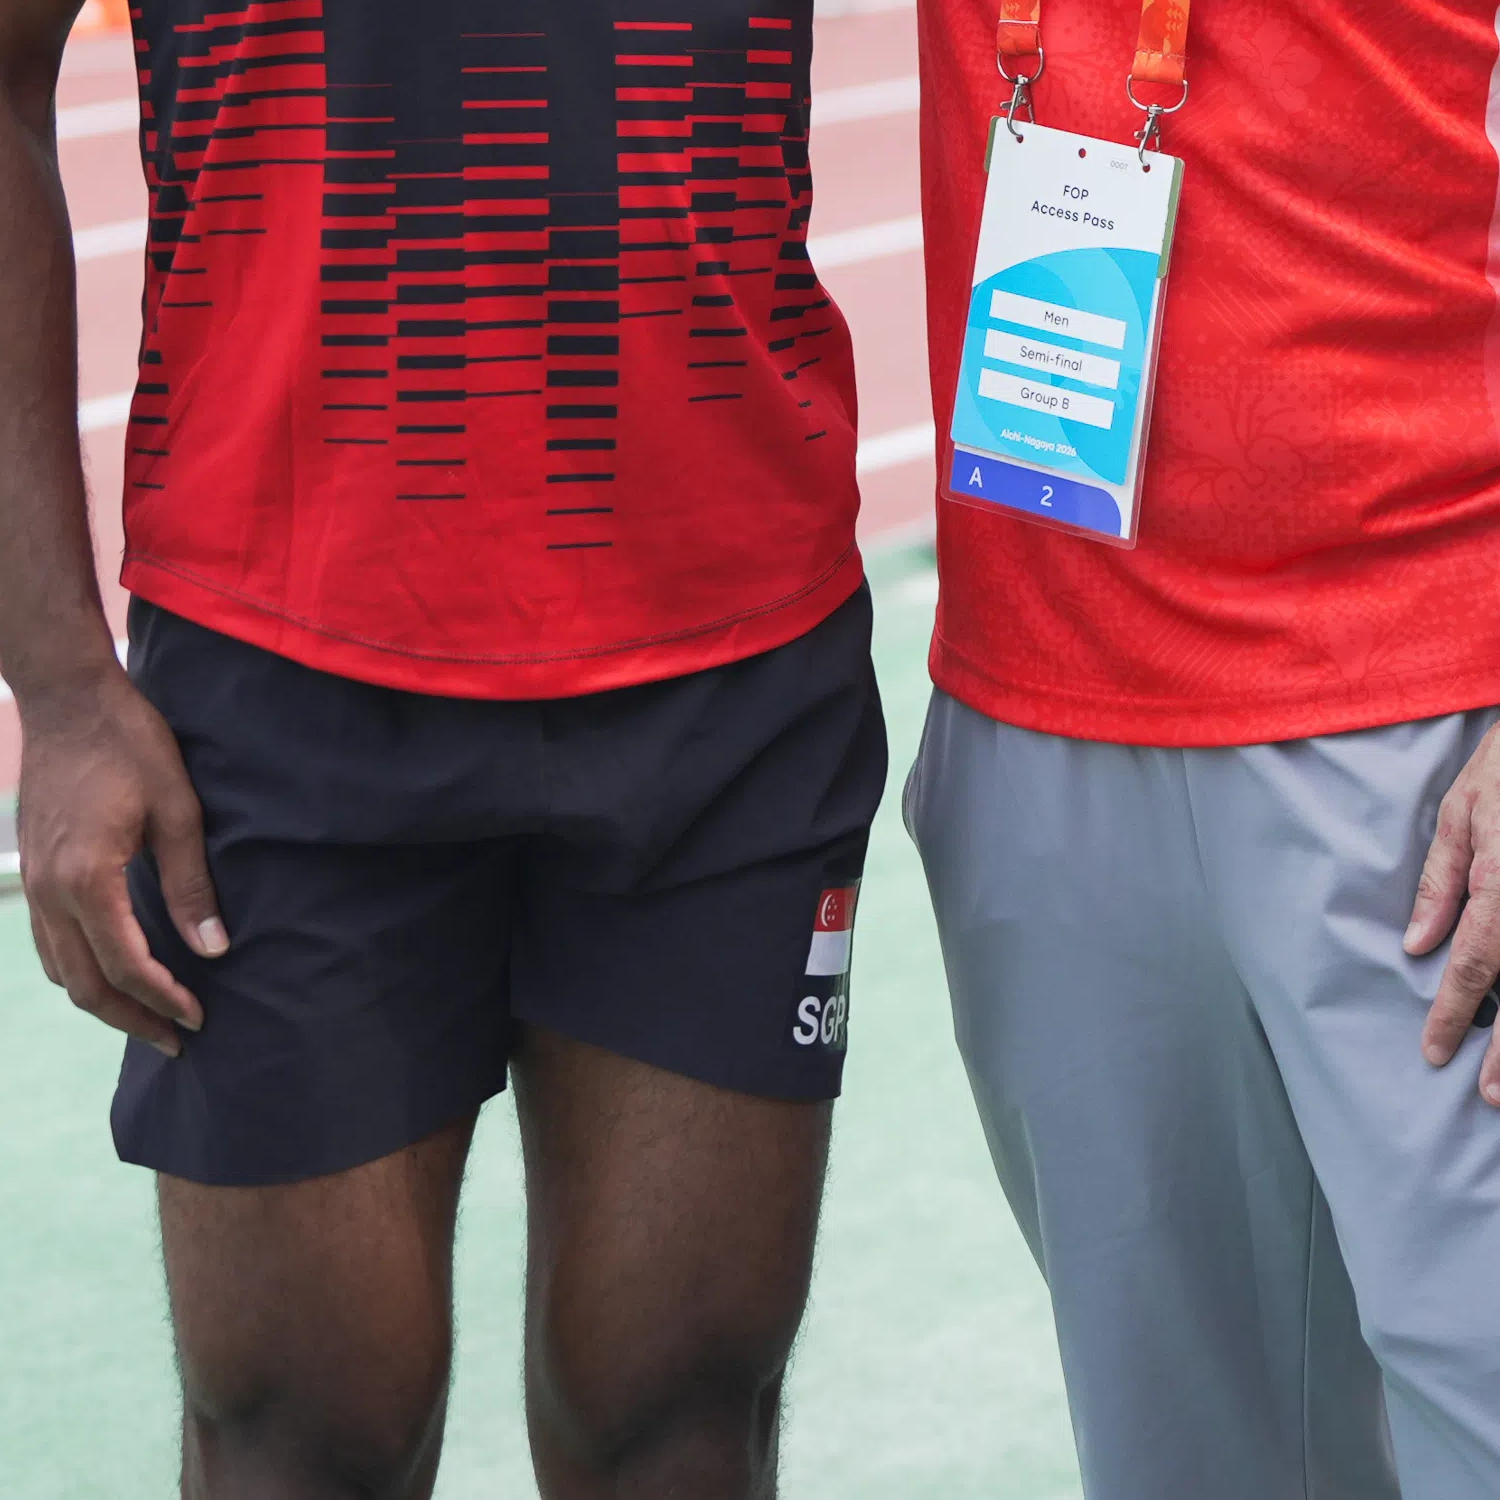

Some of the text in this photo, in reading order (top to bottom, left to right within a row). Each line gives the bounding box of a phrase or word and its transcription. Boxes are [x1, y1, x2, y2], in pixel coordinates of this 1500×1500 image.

[1062, 184, 1089, 200] FOP
[1030, 200, 1115, 231] Access Pass
[1044, 311, 1069, 328] Men
[1019, 345, 1083, 372] Semi-final
[1020, 386, 1070, 410] Group B
[1001, 428, 1078, 457] Aichi-Nagoya 2026
[968, 466, 1054, 507] A 2
[793, 994, 847, 1045] SGP
